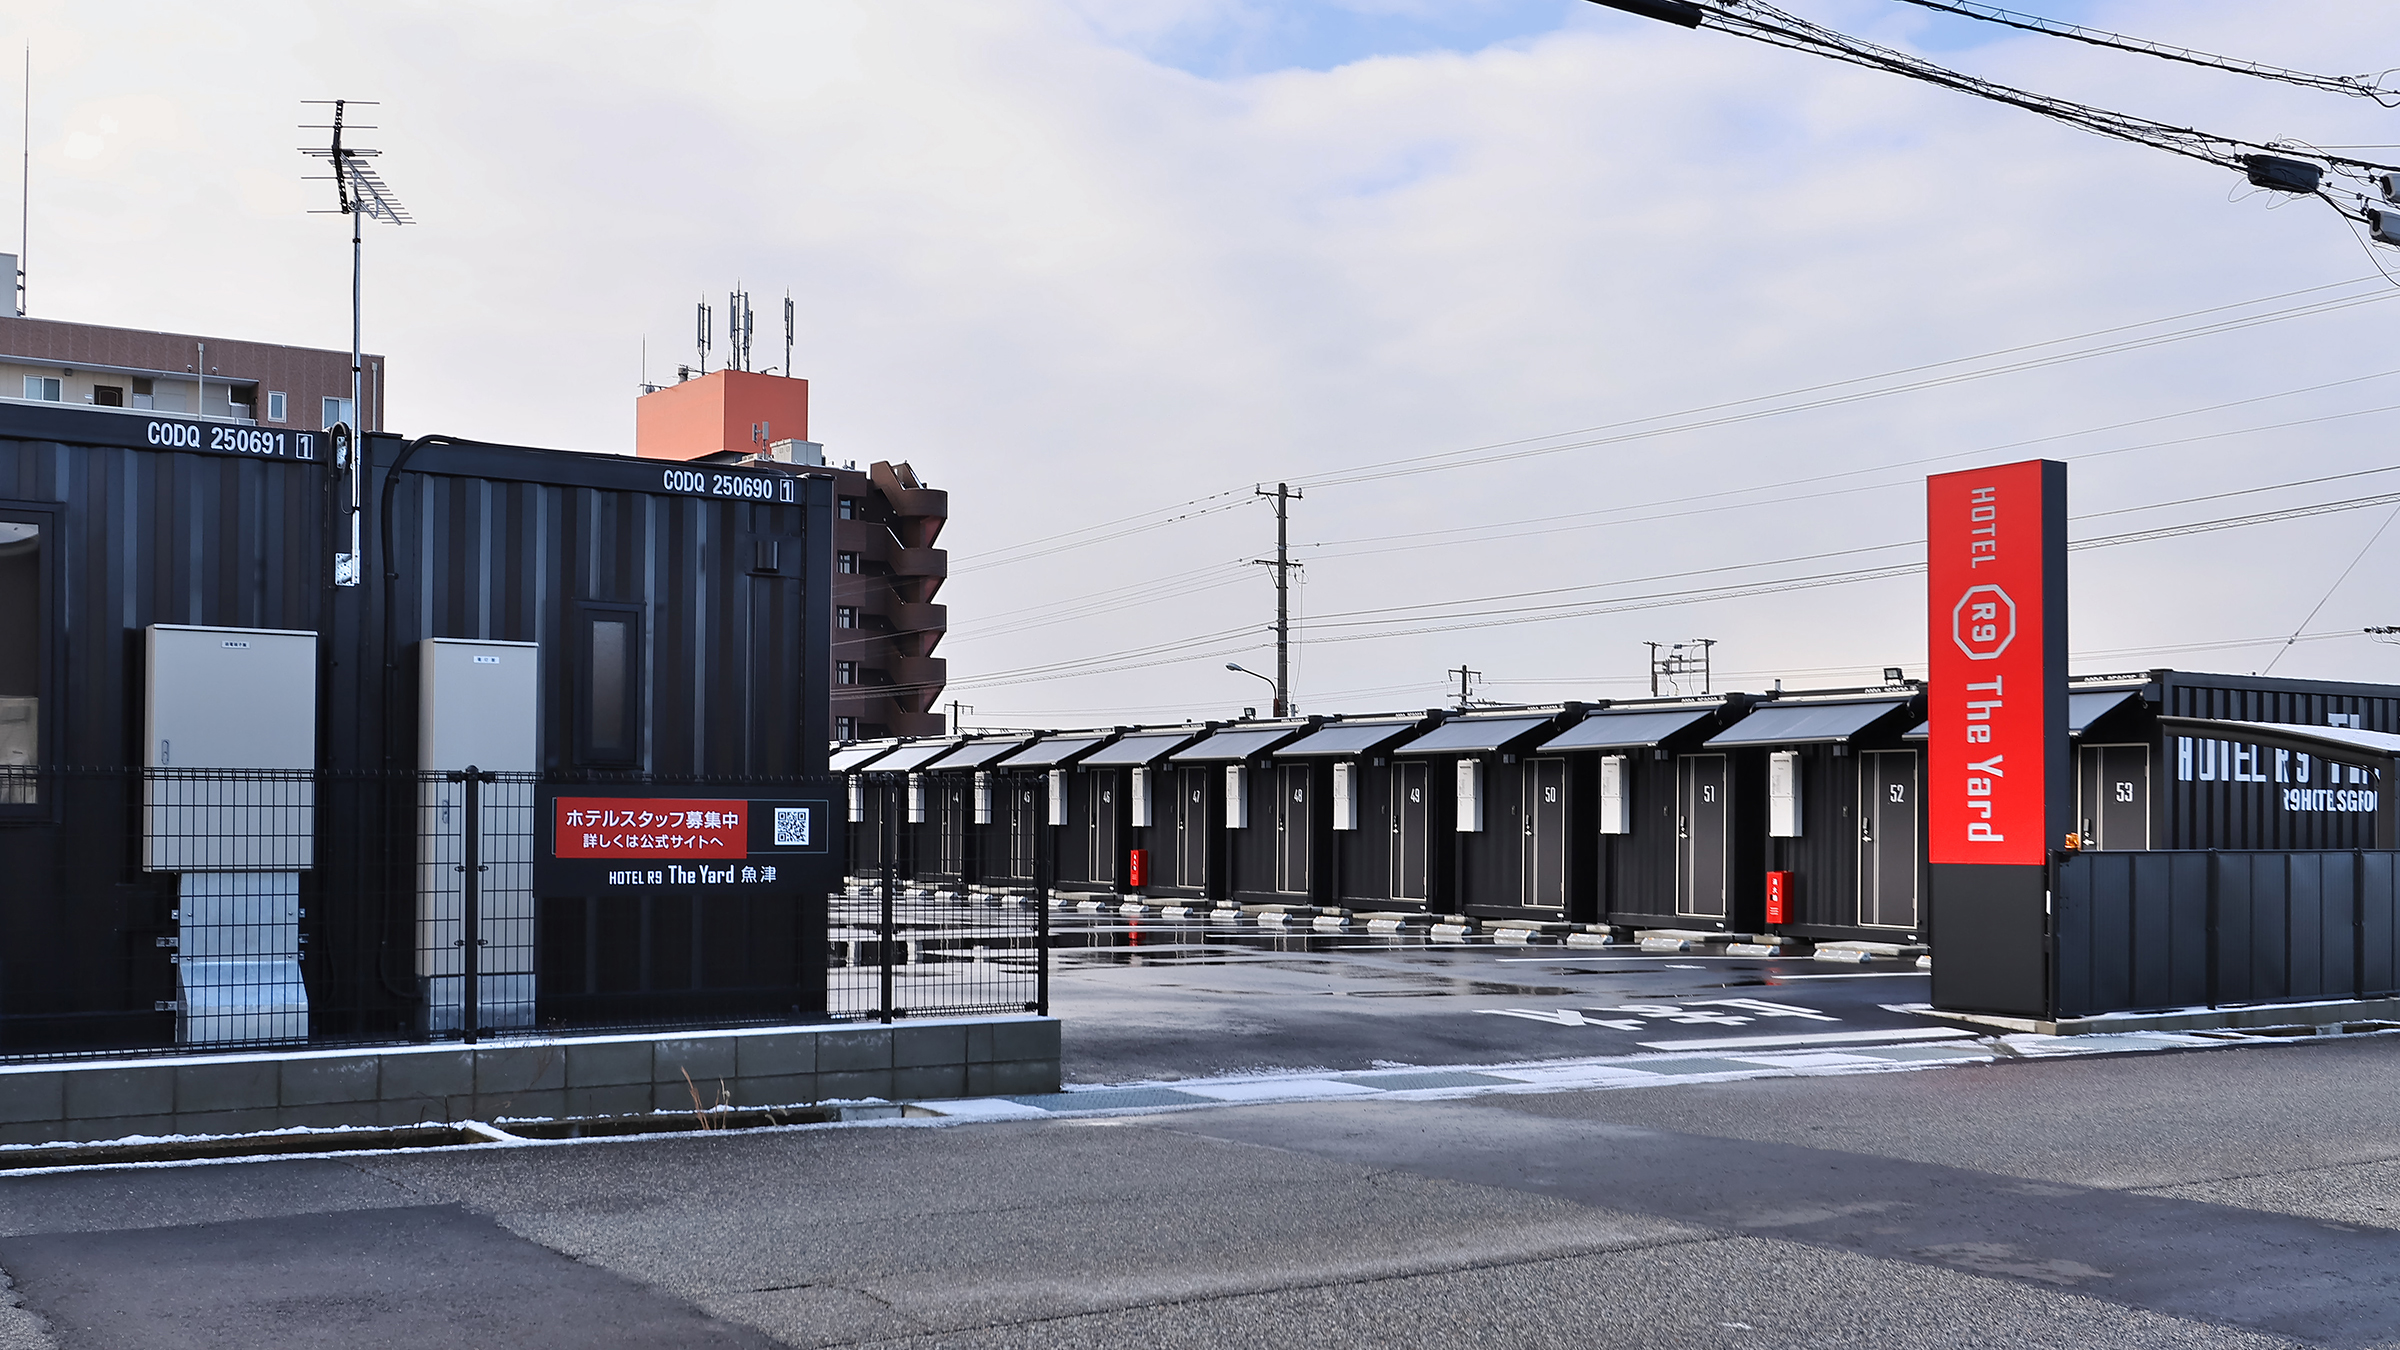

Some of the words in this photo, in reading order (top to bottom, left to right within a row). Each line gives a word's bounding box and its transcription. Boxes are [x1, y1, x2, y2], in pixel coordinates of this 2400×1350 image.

[147, 421, 201, 449] CODQ
[210, 427, 286, 456] 250691
[663, 470, 705, 493] CODQ
[712, 475, 773, 499] 250690
[1971, 486, 1997, 569] HOTEL
[1970, 602, 1997, 642] R9
[1966, 675, 2003, 744] The
[1410, 788, 1420, 803] 49
[1544, 786, 1556, 803] 50
[1703, 785, 1715, 803] 51
[1888, 784, 1905, 804] 52
[1966, 755, 2004, 842] Yard
[2114, 782, 2134, 803] 53
[566, 809, 739, 830] ホテルスタッフ募集中
[582, 833, 724, 850] 詳しくは公式サイトへ
[609, 870, 645, 885] HOTEL
[647, 870, 663, 885] R9
[667, 864, 696, 884] The
[698, 864, 735, 884] Yard
[741, 865, 777, 884] 魚津
